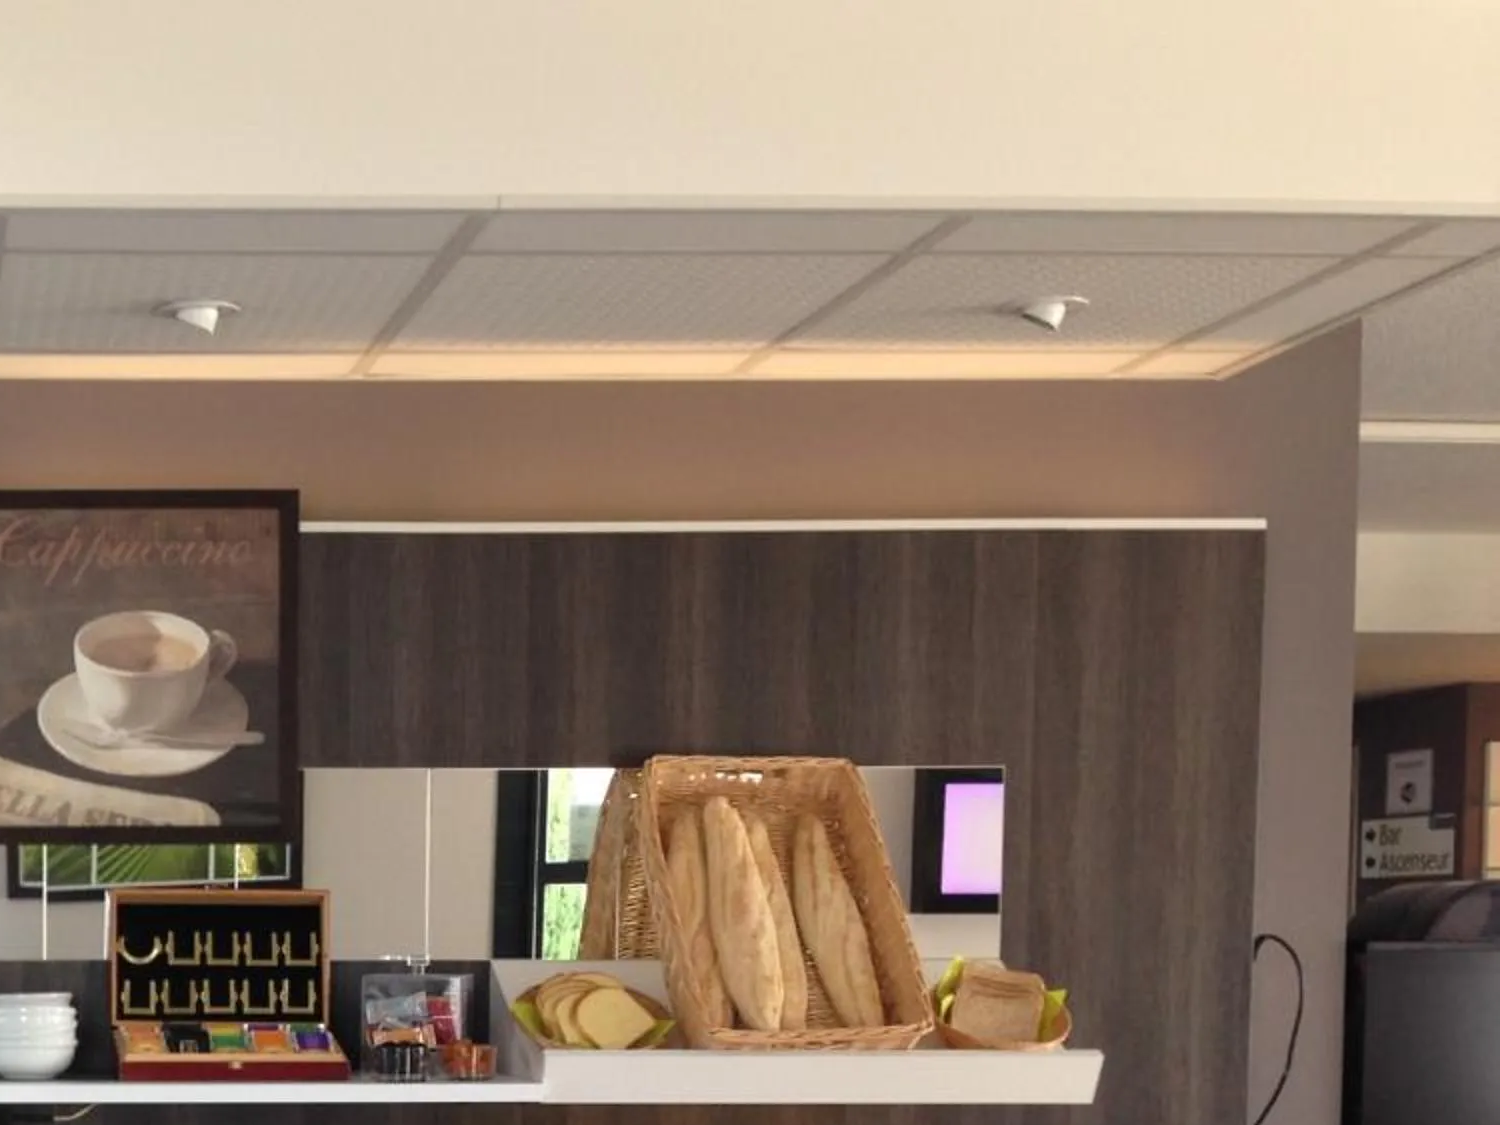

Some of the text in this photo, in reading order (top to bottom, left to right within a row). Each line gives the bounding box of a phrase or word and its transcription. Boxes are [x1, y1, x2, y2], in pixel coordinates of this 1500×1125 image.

[83, 807, 174, 827] SE
[1379, 824, 1402, 846] Bar
[1380, 851, 1449, 872] Ascenseur
